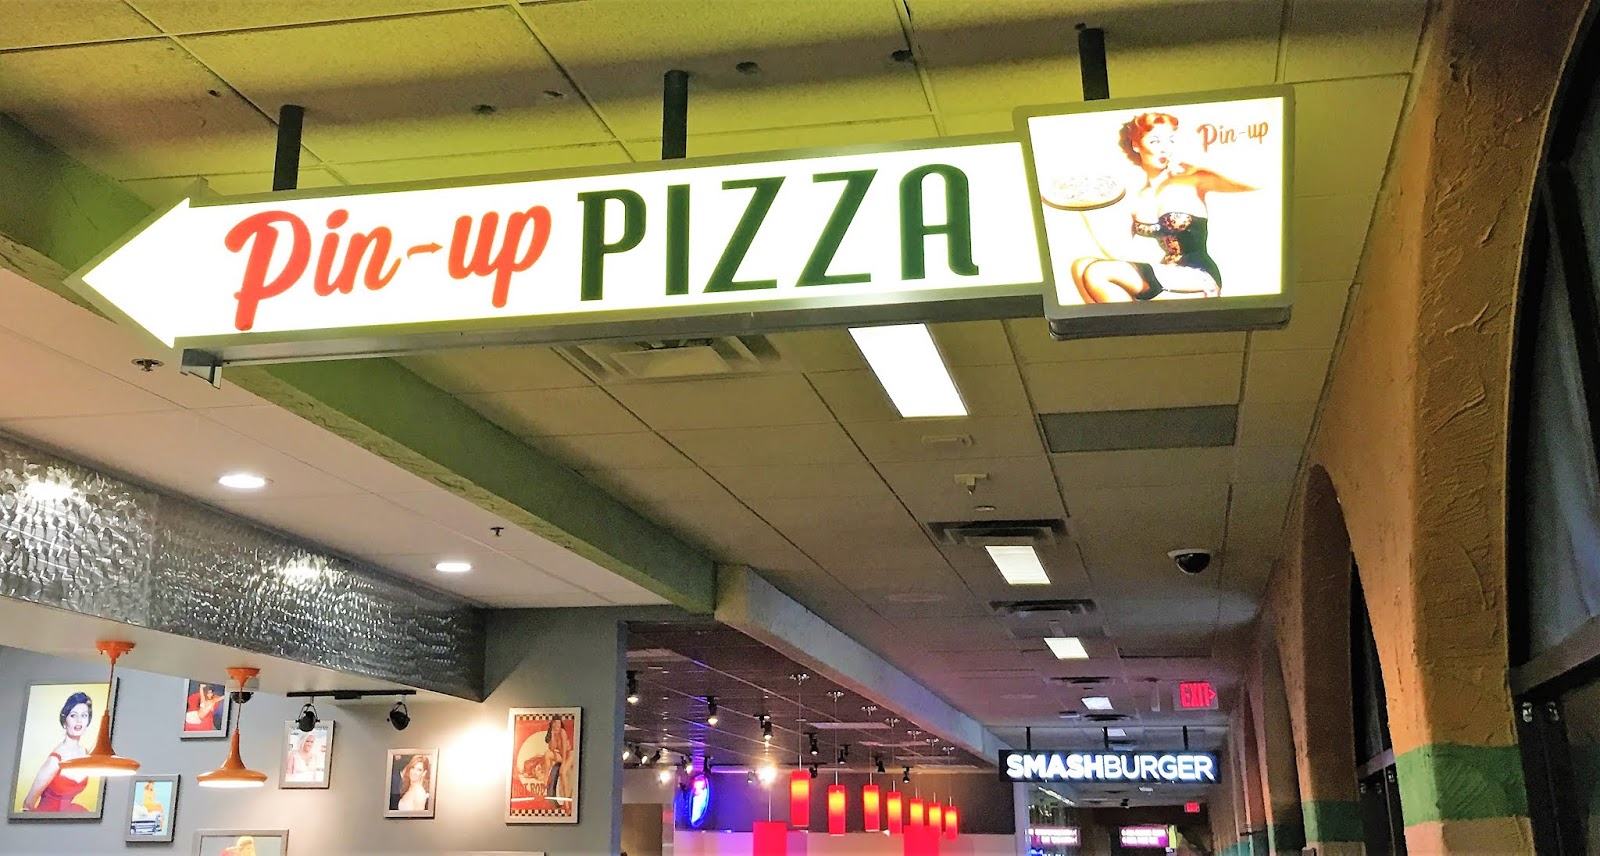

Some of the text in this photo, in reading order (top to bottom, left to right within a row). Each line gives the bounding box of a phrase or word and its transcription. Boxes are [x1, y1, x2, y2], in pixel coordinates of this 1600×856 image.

[1196, 121, 1269, 153] Pin-up
[224, 163, 980, 332] Pin-up PIZZA
[1180, 682, 1210, 707] EXIT
[1006, 753, 1215, 781] SMASHBURGER
